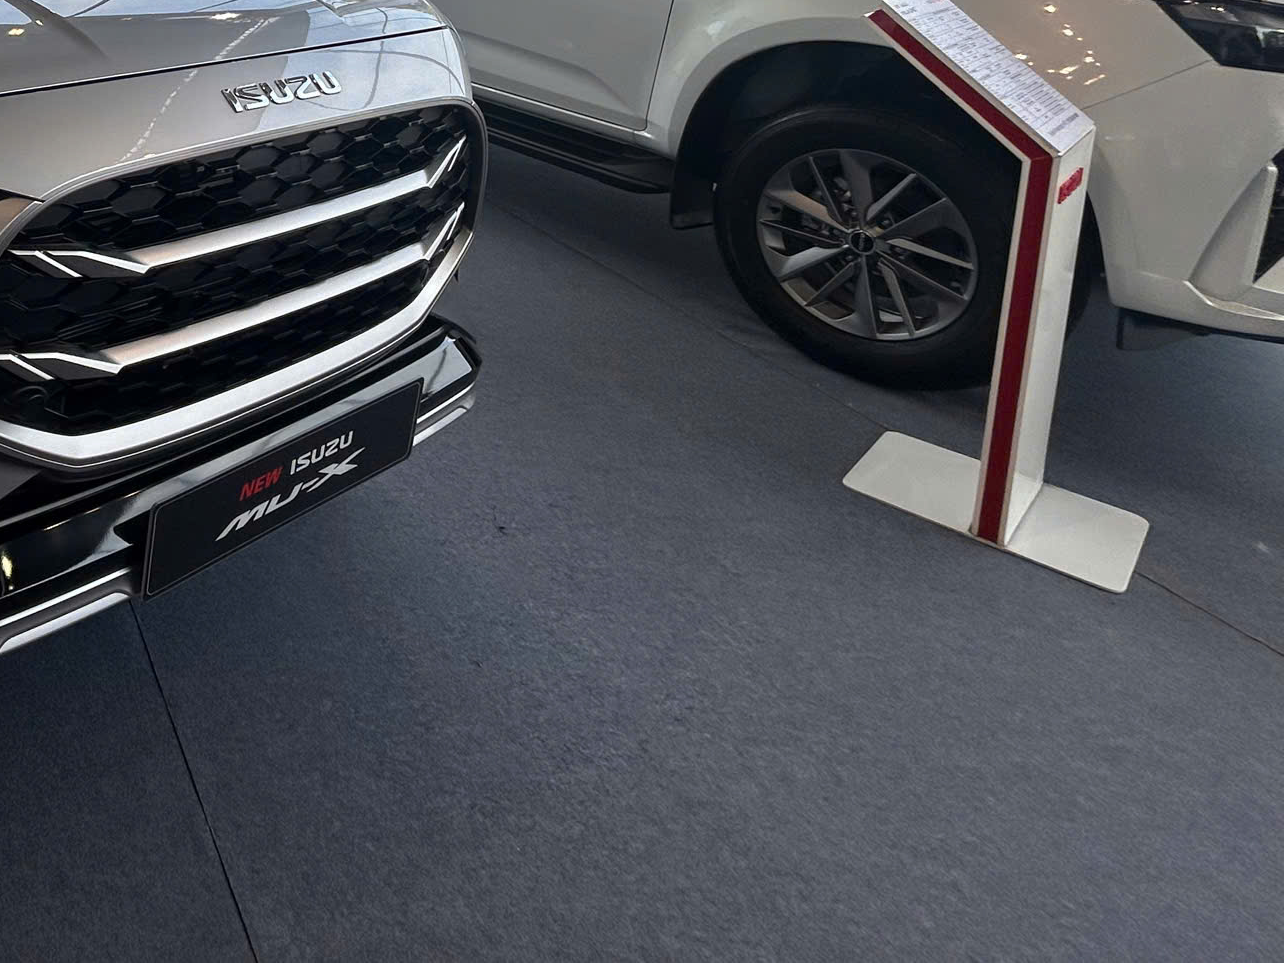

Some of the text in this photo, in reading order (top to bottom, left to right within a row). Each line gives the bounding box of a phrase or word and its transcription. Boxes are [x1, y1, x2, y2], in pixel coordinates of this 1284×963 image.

[220, 71, 342, 113] ISUZU
[239, 430, 354, 501] NEW ISUZU
